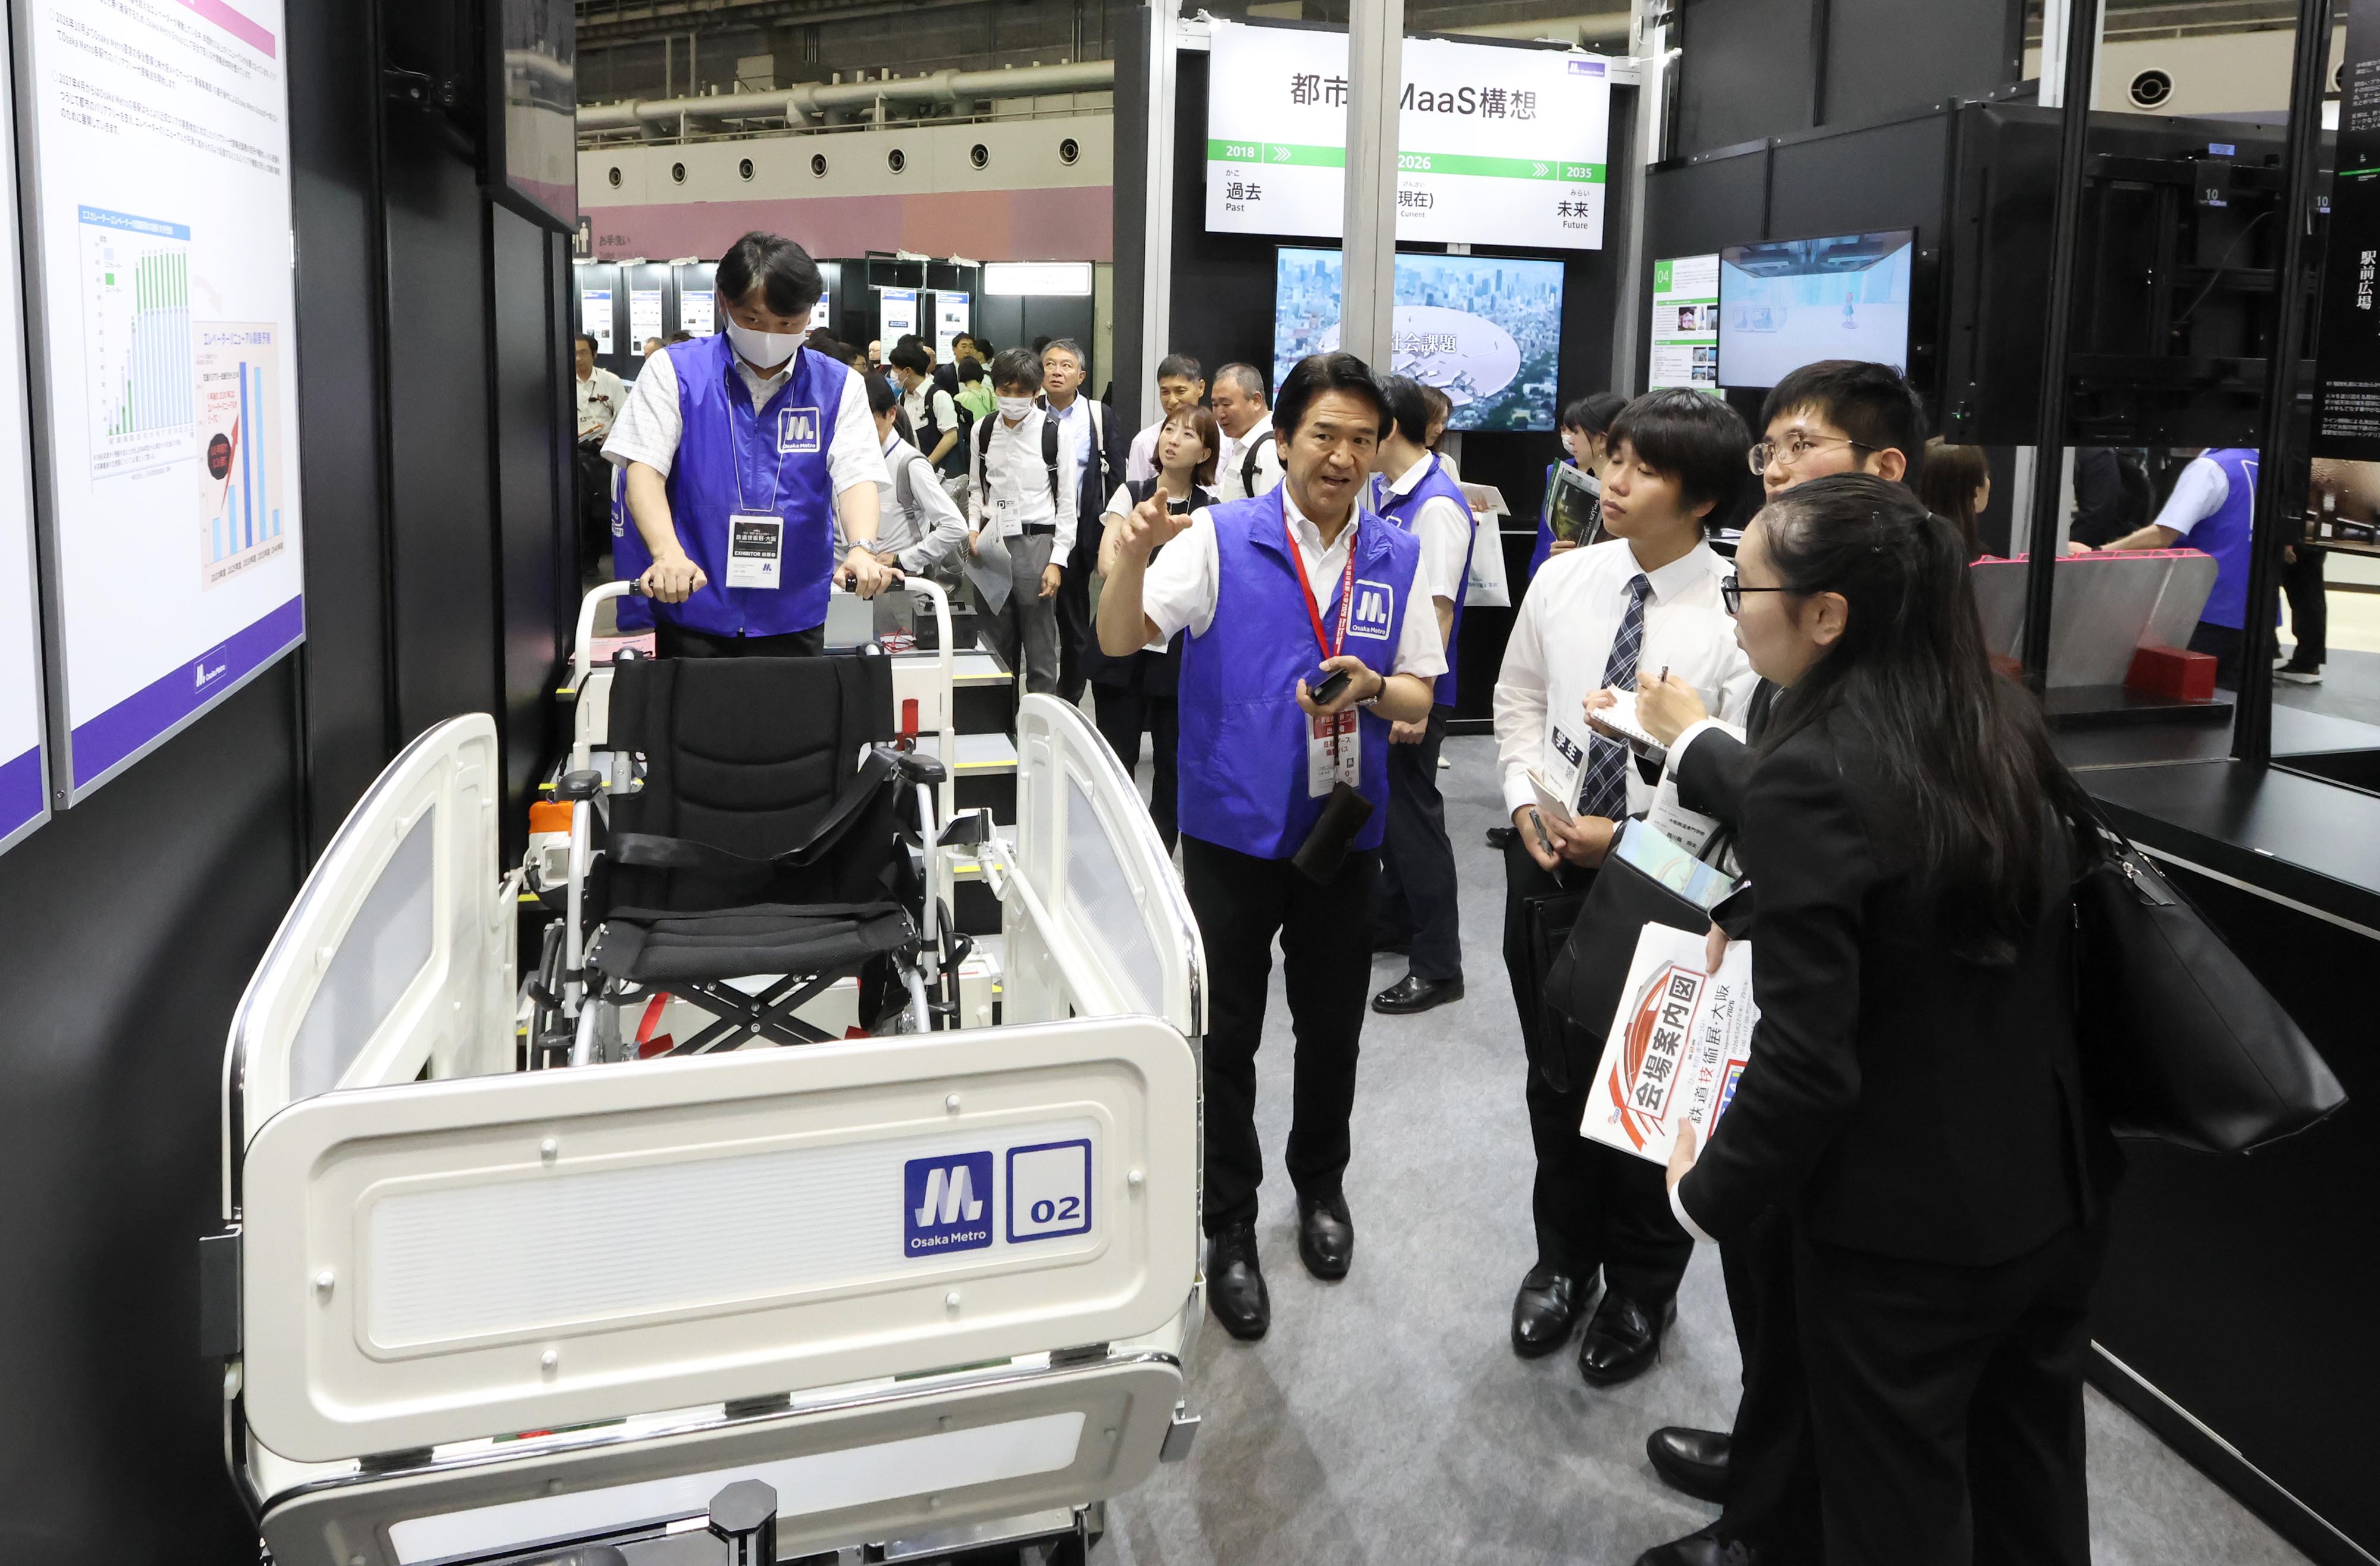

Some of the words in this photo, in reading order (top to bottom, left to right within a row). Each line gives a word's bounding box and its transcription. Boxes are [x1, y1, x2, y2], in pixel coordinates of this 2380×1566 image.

[1226, 145, 1255, 159] 2018
[1398, 155, 1432, 171] 2026
[1567, 166, 1592, 179] 2035
[1226, 182, 1262, 201] 過去
[1557, 200, 1589, 218] 未来
[1226, 202, 1245, 212] Past
[1401, 210, 1426, 218] Current
[1562, 220, 1589, 230] Future
[1658, 270, 1669, 284] 04
[2356, 250, 2377, 311] 駅前広場
[1391, 332, 1457, 353] 社会課題
[1352, 624, 1370, 632] Osaka
[1370, 626, 1386, 635] Metro
[1326, 725, 1345, 735] 出者
[1555, 731, 1577, 762] 学生
[1635, 974, 1697, 1111] 会場案内図
[1687, 985, 1731, 1125] 鉄道技術展・大阪
[1726, 1000, 1735, 1017] 2026
[1031, 1196, 1080, 1224] 02
[910, 1233, 948, 1249] Osaka
[950, 1230, 987, 1244] Metro
